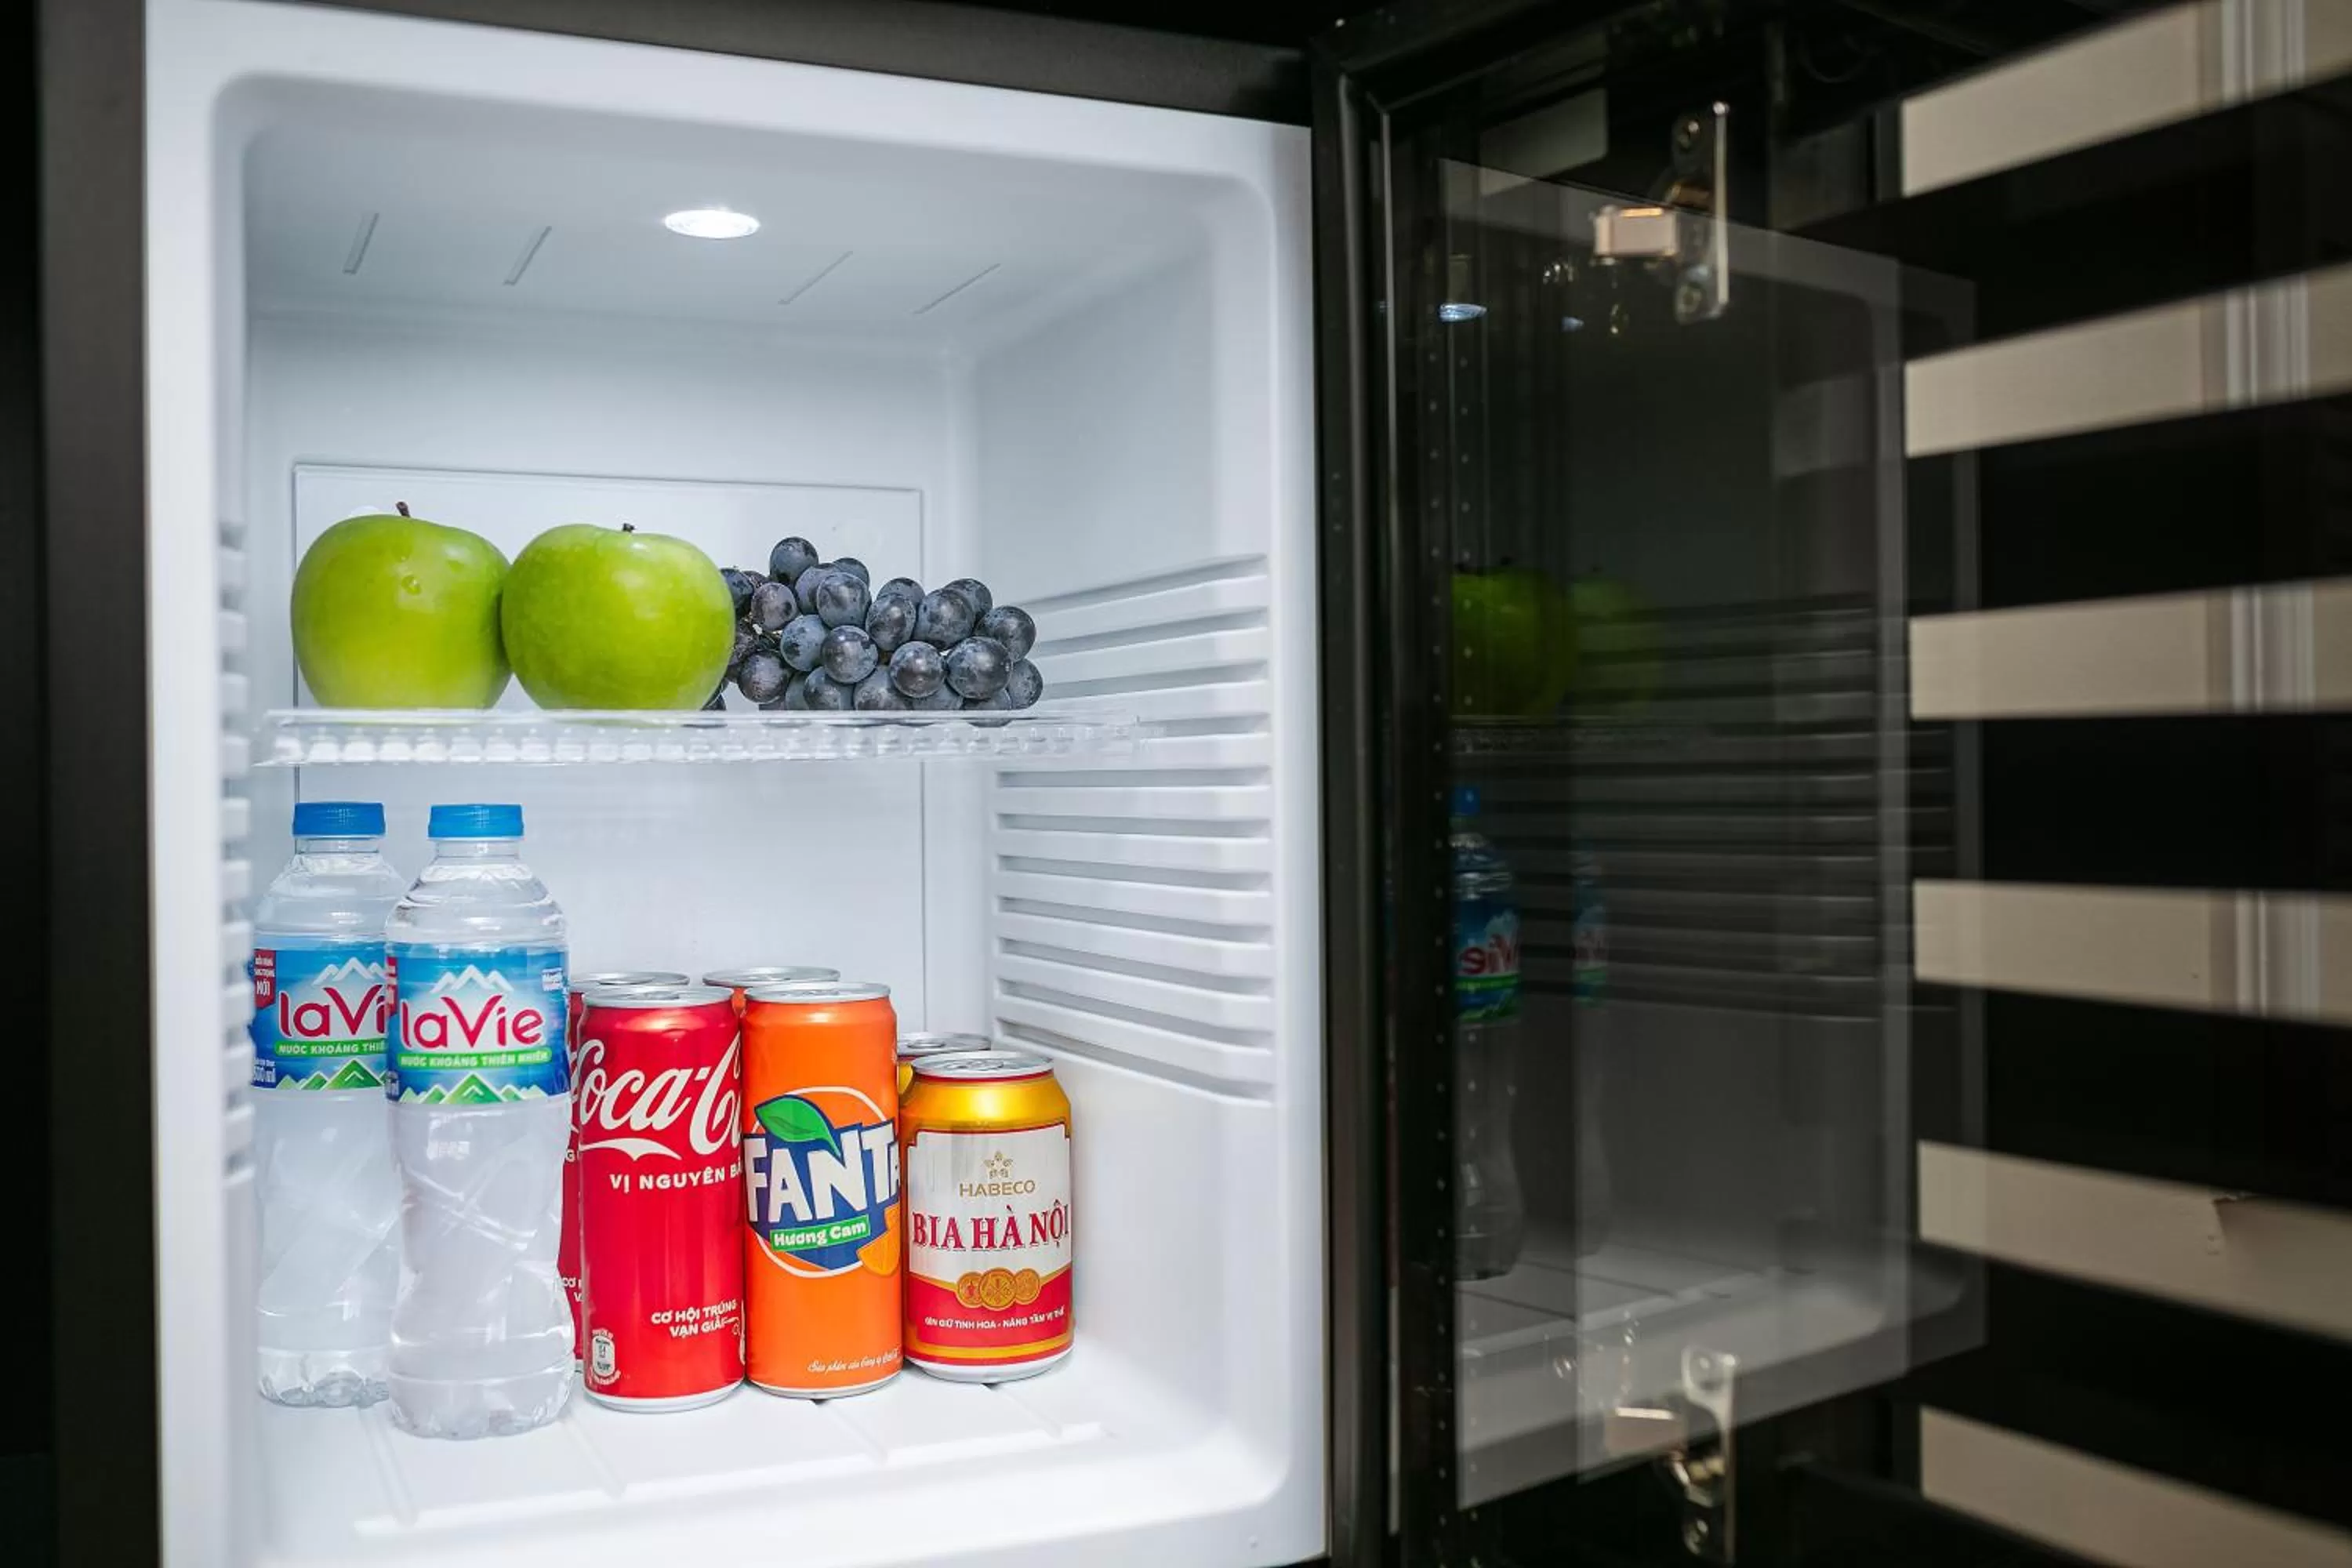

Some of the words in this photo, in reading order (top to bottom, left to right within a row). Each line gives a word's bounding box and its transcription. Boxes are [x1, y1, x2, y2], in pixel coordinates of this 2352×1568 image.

[279, 984, 386, 1037] laVi
[401, 994, 544, 1049] laVie
[609, 1174, 630, 1194] VỊ
[639, 1166, 725, 1190] NGUYÊN
[959, 1180, 1036, 1197] HABECO
[830, 1222, 866, 1240] Cam
[912, 1211, 965, 1250] BIA
[971, 1204, 1025, 1251] HÀ
[1029, 1199, 1069, 1249] NỘI
